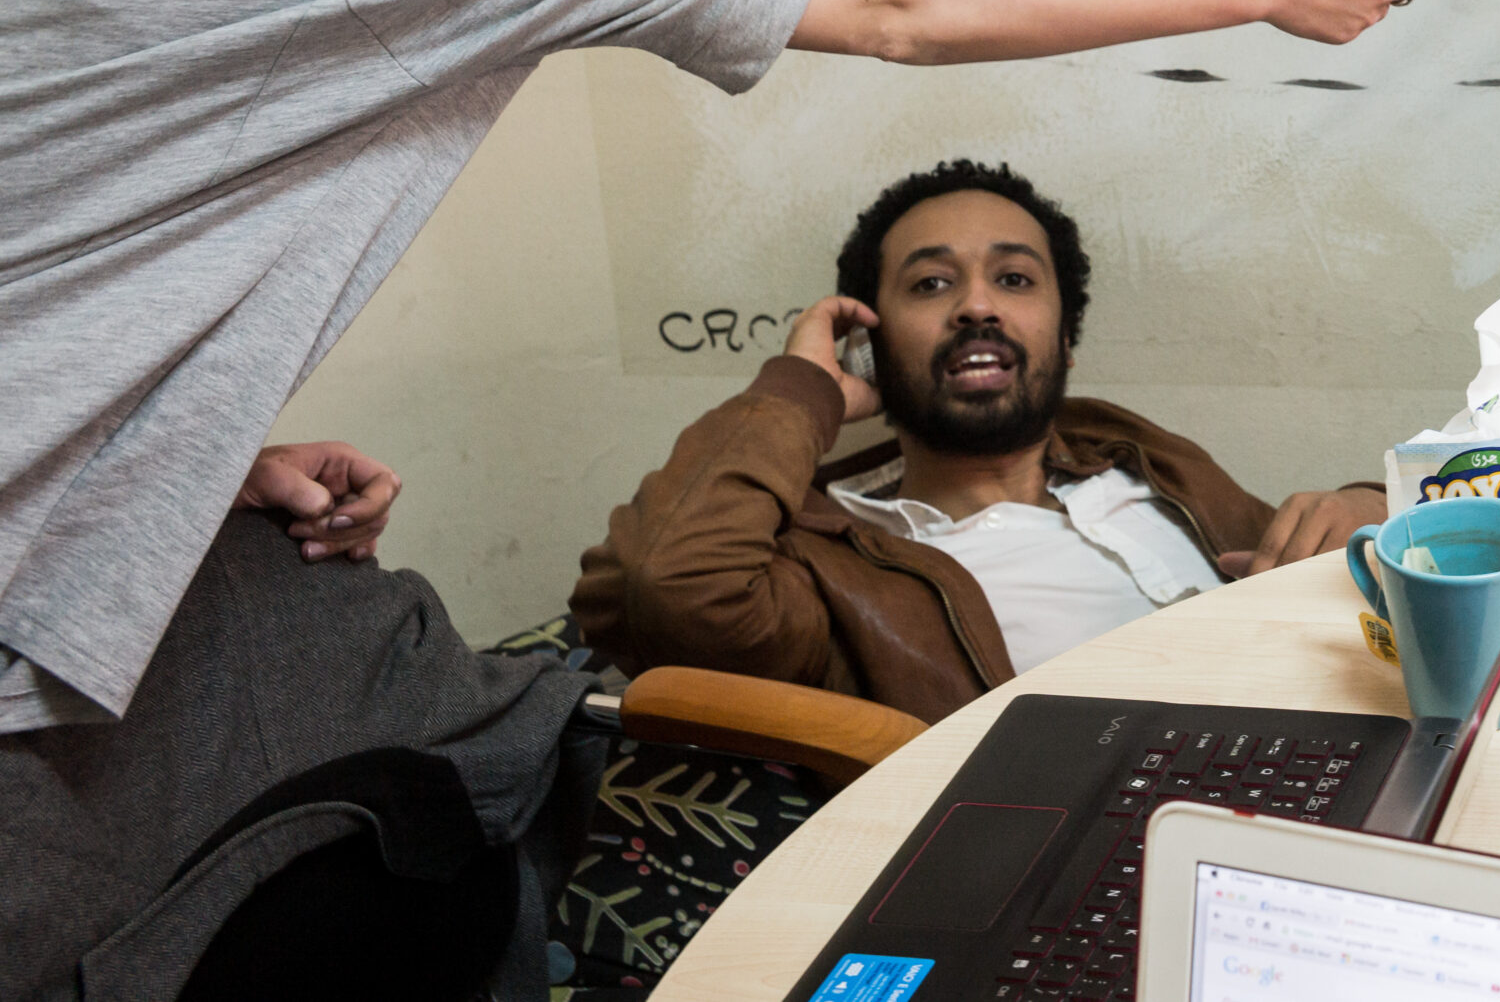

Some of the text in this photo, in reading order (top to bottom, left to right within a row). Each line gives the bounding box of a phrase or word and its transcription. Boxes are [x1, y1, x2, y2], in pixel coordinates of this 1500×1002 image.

[1106, 889, 1121, 897] N
[1090, 913, 1106, 922] M
[1222, 954, 1285, 987] Google
